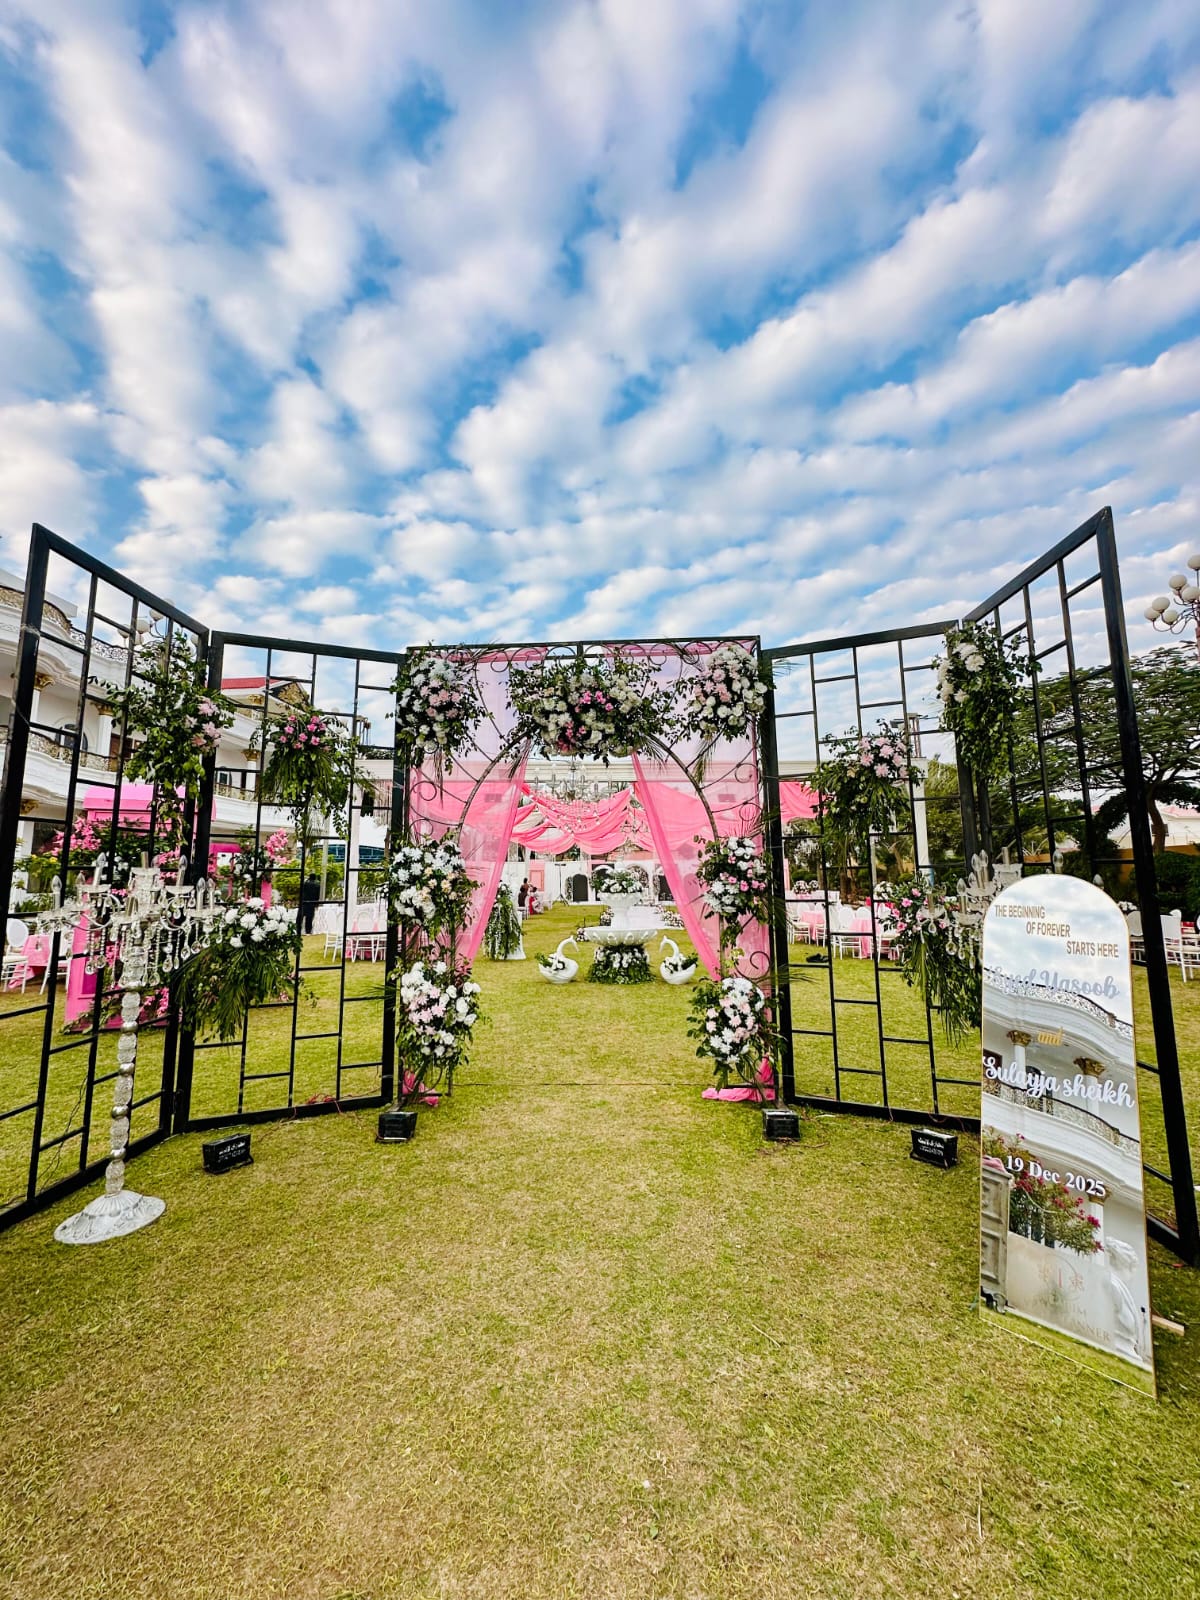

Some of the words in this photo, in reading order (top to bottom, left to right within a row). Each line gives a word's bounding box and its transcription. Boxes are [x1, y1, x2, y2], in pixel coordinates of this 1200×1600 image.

[995, 904, 1007, 918] THE
[1008, 905, 1046, 919] BEGINNING
[1026, 921, 1036, 935] OF
[1036, 922, 1071, 938] FOREVER
[1066, 940, 1096, 957] STARTS
[1097, 943, 1120, 958] HERE
[1037, 1026, 1065, 1047] and
[1063, 1074, 1135, 1108] sheikh
[1006, 1155, 1024, 1172] 19
[1028, 1160, 1061, 1184] Dec
[1065, 1172, 1106, 1197] 2025
